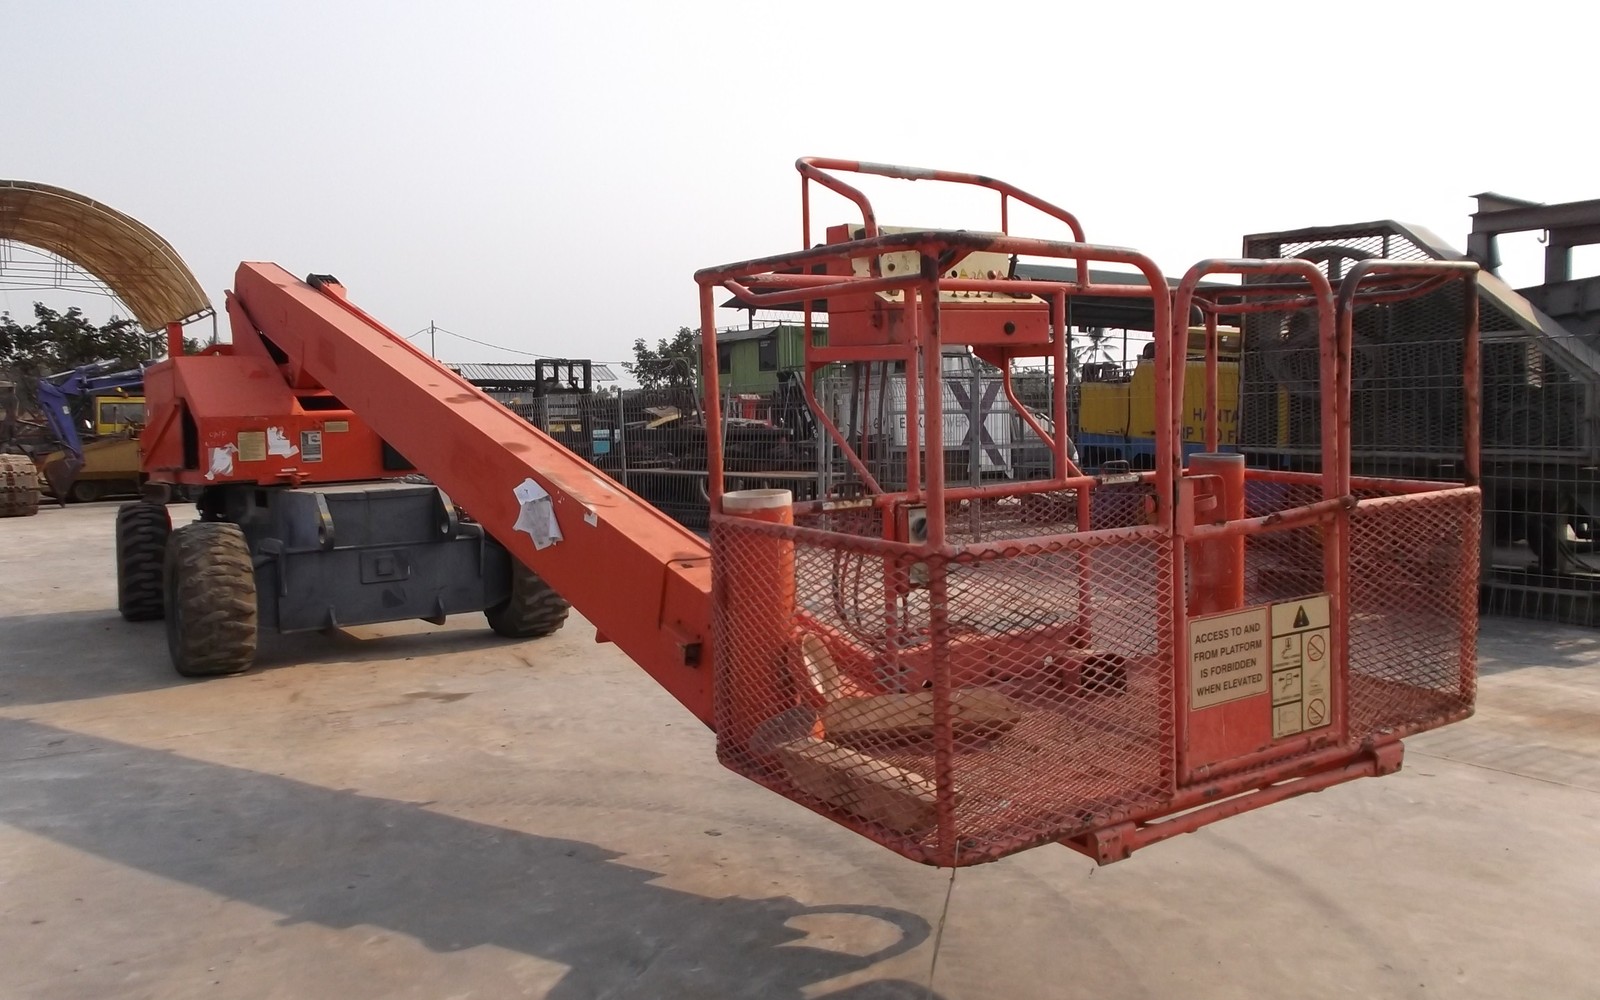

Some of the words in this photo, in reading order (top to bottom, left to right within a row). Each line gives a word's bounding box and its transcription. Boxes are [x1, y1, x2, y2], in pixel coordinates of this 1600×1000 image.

[1195, 627, 1229, 645] ACCESS
[1231, 626, 1242, 637] TO
[1243, 623, 1261, 634] AND
[1193, 648, 1218, 662] FROM
[1220, 640, 1262, 657] PLATFORM
[1200, 668, 1209, 678] IS
[1210, 658, 1257, 676] FORBIDDEN
[1197, 683, 1221, 697] WHEN
[1223, 673, 1263, 690] ELEVATED
